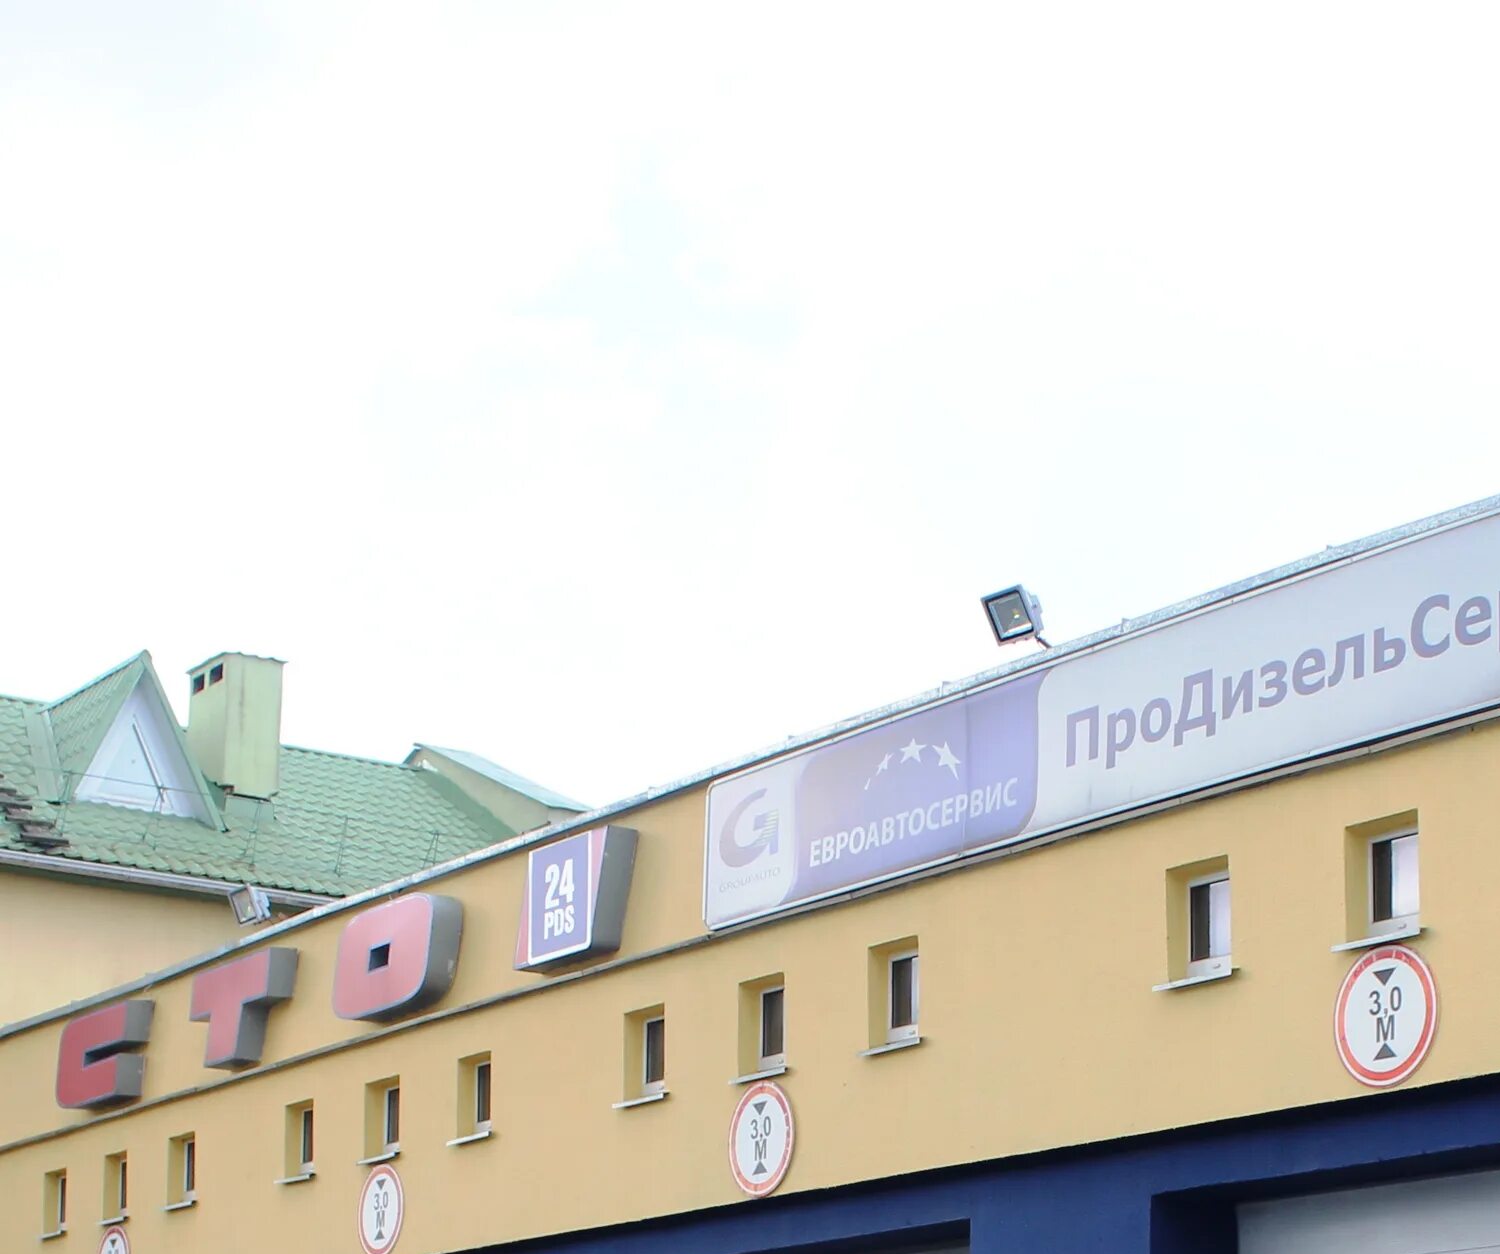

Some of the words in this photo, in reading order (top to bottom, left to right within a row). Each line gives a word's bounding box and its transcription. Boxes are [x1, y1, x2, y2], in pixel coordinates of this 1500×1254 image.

[808, 777, 1019, 868] ЕВРОАВТОСЕРВИС
[544, 858, 575, 910] 24
[543, 905, 576, 940] PDS
[1368, 986, 1403, 1018] 3,0
[750, 1115, 772, 1141] 3,0
